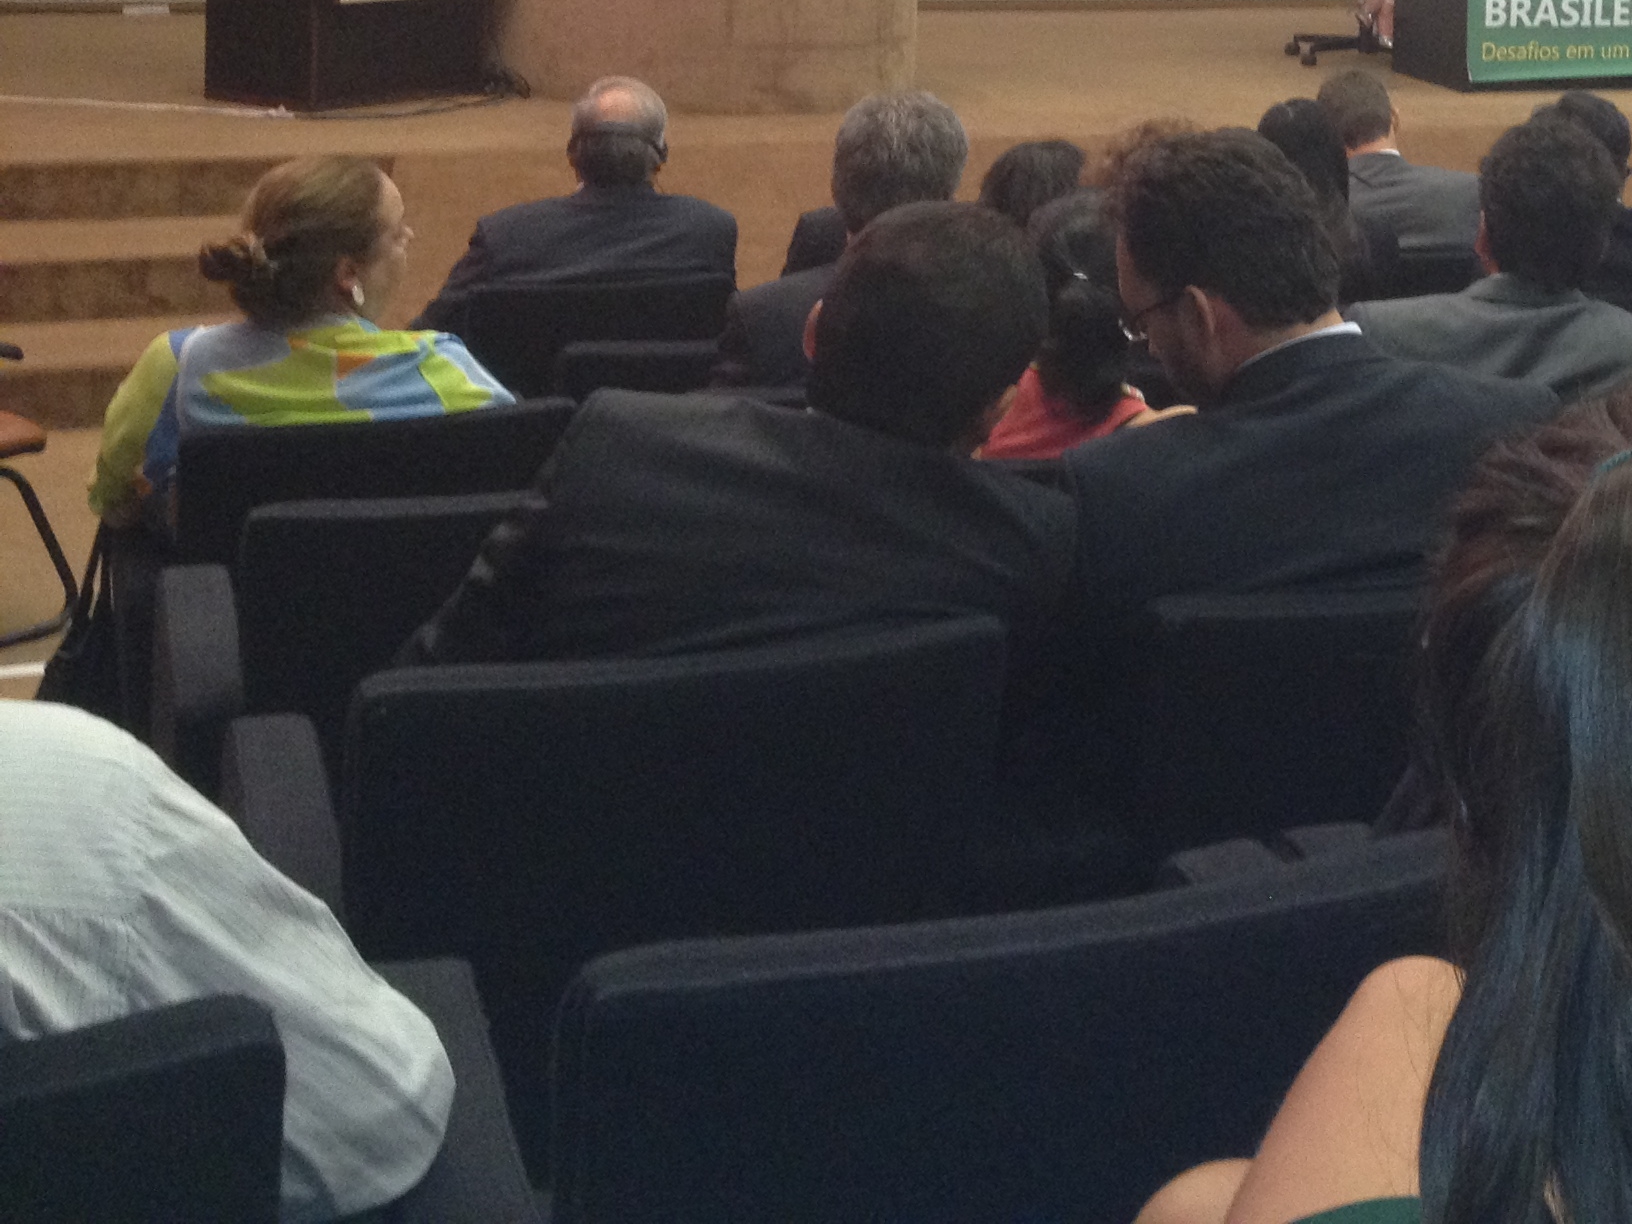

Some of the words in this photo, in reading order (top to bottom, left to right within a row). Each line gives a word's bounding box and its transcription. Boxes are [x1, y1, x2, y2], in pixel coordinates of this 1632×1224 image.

[1481, 41, 1560, 61] Desafios
[1566, 44, 1594, 59] em
[1601, 44, 1630, 59] um
